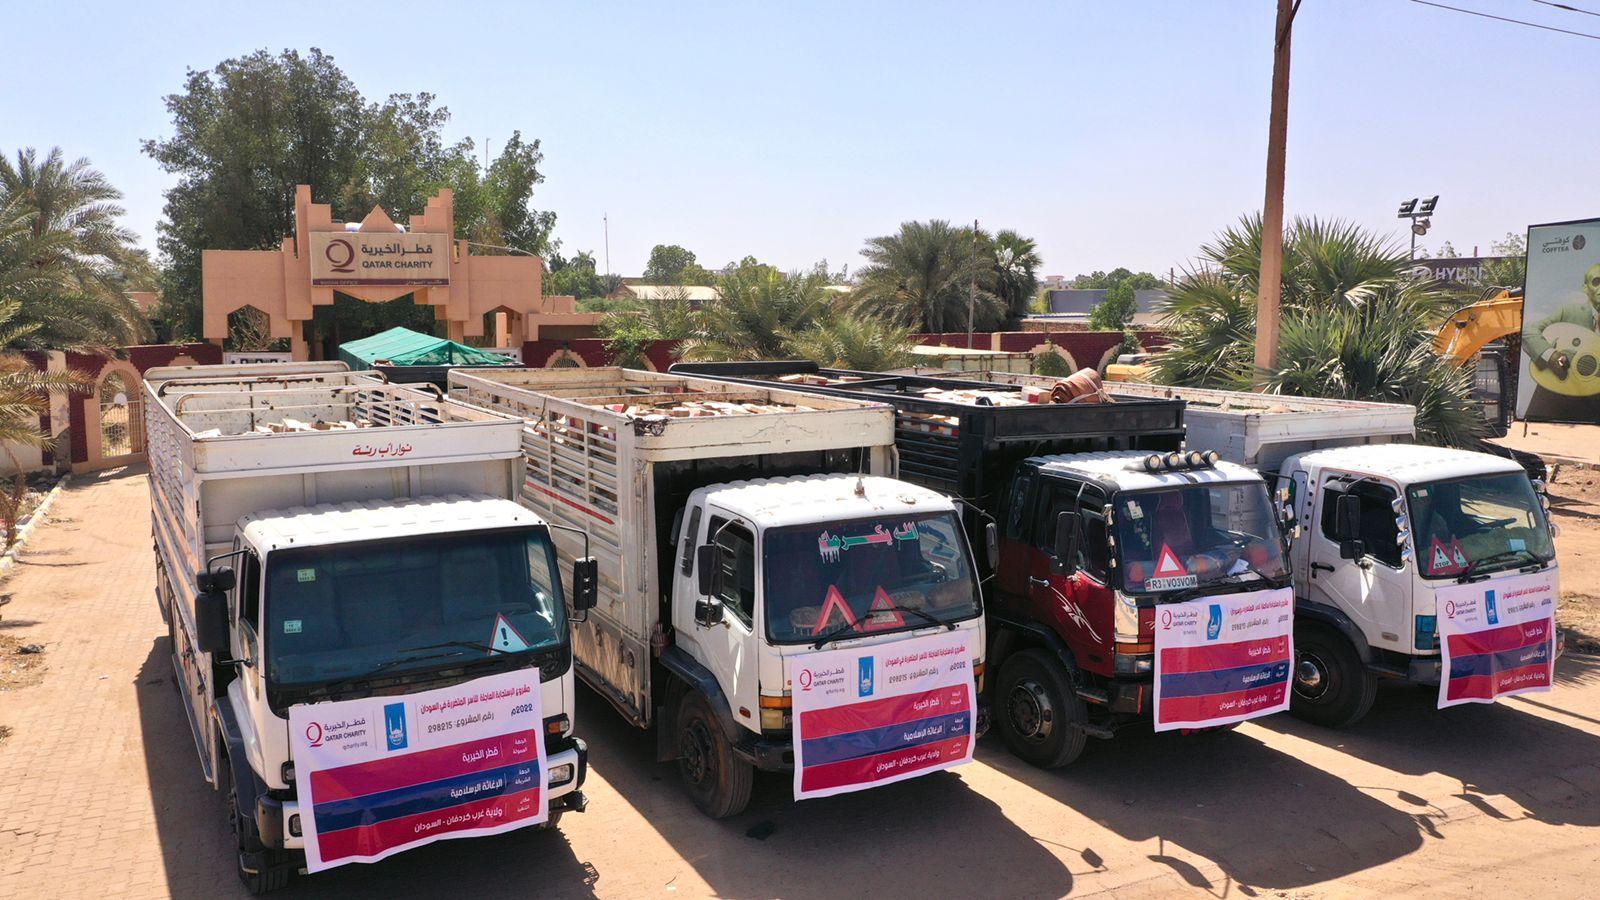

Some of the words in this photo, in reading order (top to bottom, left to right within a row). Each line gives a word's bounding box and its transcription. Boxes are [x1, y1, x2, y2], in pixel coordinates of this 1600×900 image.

[361, 243, 400, 256] الخيرية
[401, 244, 432, 256] قطر
[362, 261, 392, 269] QATAR
[420, 702, 440, 715] السودان
[482, 711, 494, 722] رقم
[324, 721, 346, 732] الخيرية
[346, 718, 366, 729] قطر
[428, 721, 453, 733] 298215
[325, 733, 342, 742] QATAR
[343, 729, 366, 739] CHARITY
[462, 749, 485, 763] الخيرية
[485, 746, 499, 759] قطر
[446, 812, 471, 825] كردفان
[472, 810, 484, 820] غرب
[486, 807, 502, 818] ولاية
[414, 819, 441, 833] السودان
